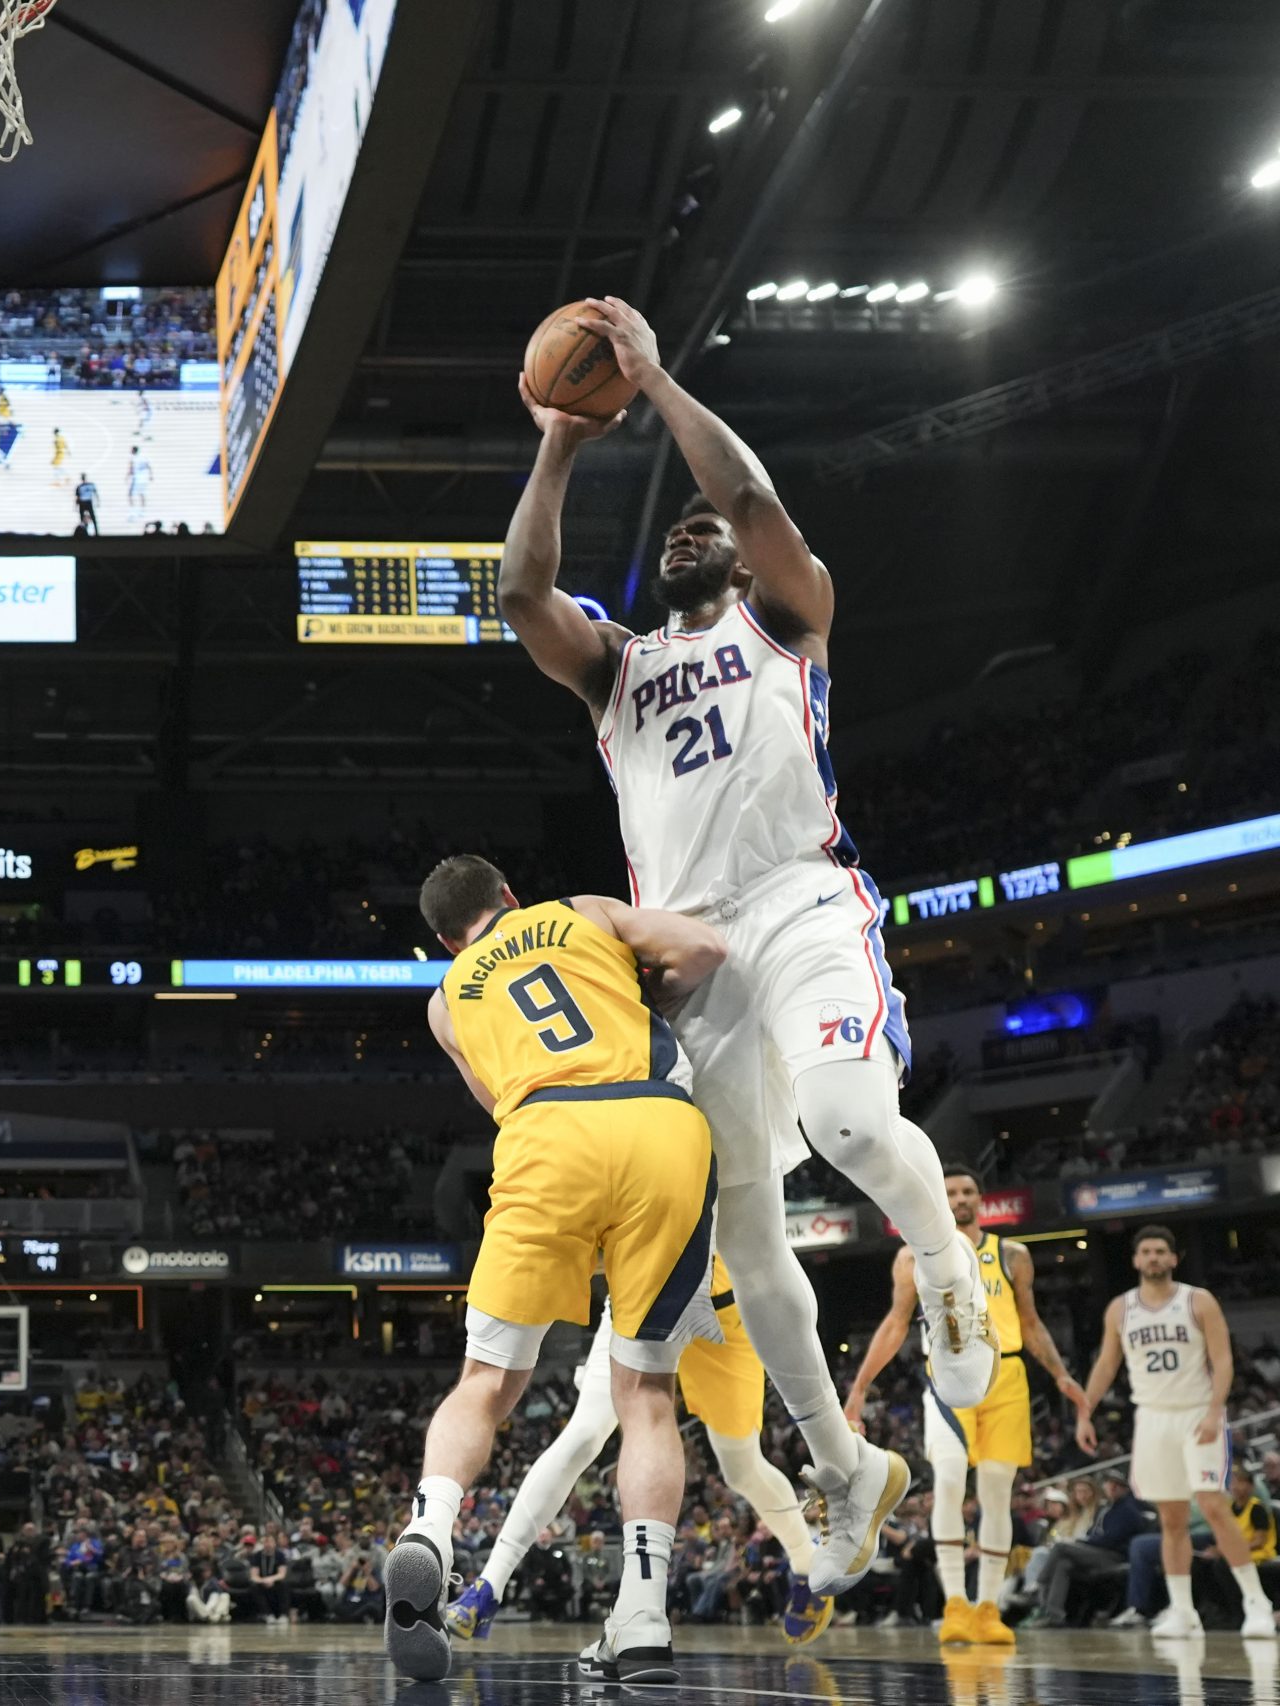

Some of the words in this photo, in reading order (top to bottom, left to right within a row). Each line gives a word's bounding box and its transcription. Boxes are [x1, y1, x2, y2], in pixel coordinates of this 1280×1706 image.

[632, 644, 752, 733] PHILA
[665, 704, 733, 778] 21
[41, 970, 54, 985] 3
[110, 961, 142, 985] 99
[233, 965, 356, 981] PHILADELPHIA
[360, 965, 413, 981] 76ERS
[507, 962, 595, 1053] 9
[819, 1016, 864, 1047] 76
[150, 1250, 228, 1268] motorola
[344, 1246, 402, 1272] ksm
[1146, 1348, 1179, 1373] 20
